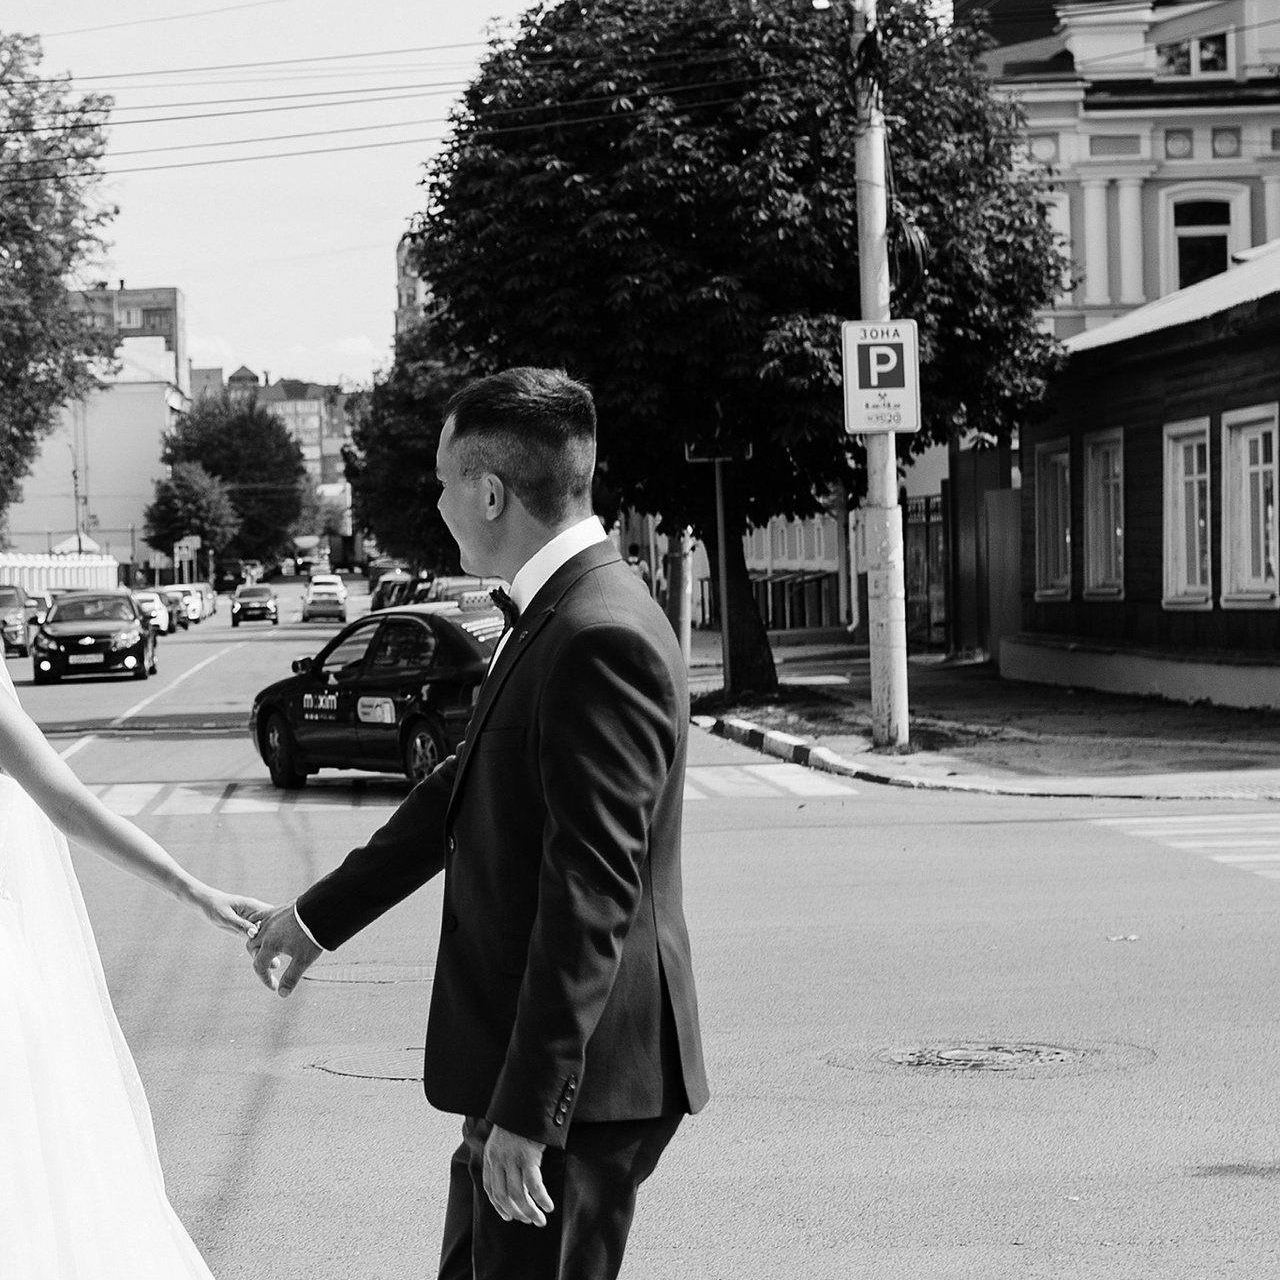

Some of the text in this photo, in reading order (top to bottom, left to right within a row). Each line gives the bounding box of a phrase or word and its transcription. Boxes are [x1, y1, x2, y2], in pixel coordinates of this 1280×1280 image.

[860, 328, 900, 340] ЗОНА
[869, 345, 898, 387] P
[303, 689, 338, 709] mxim
